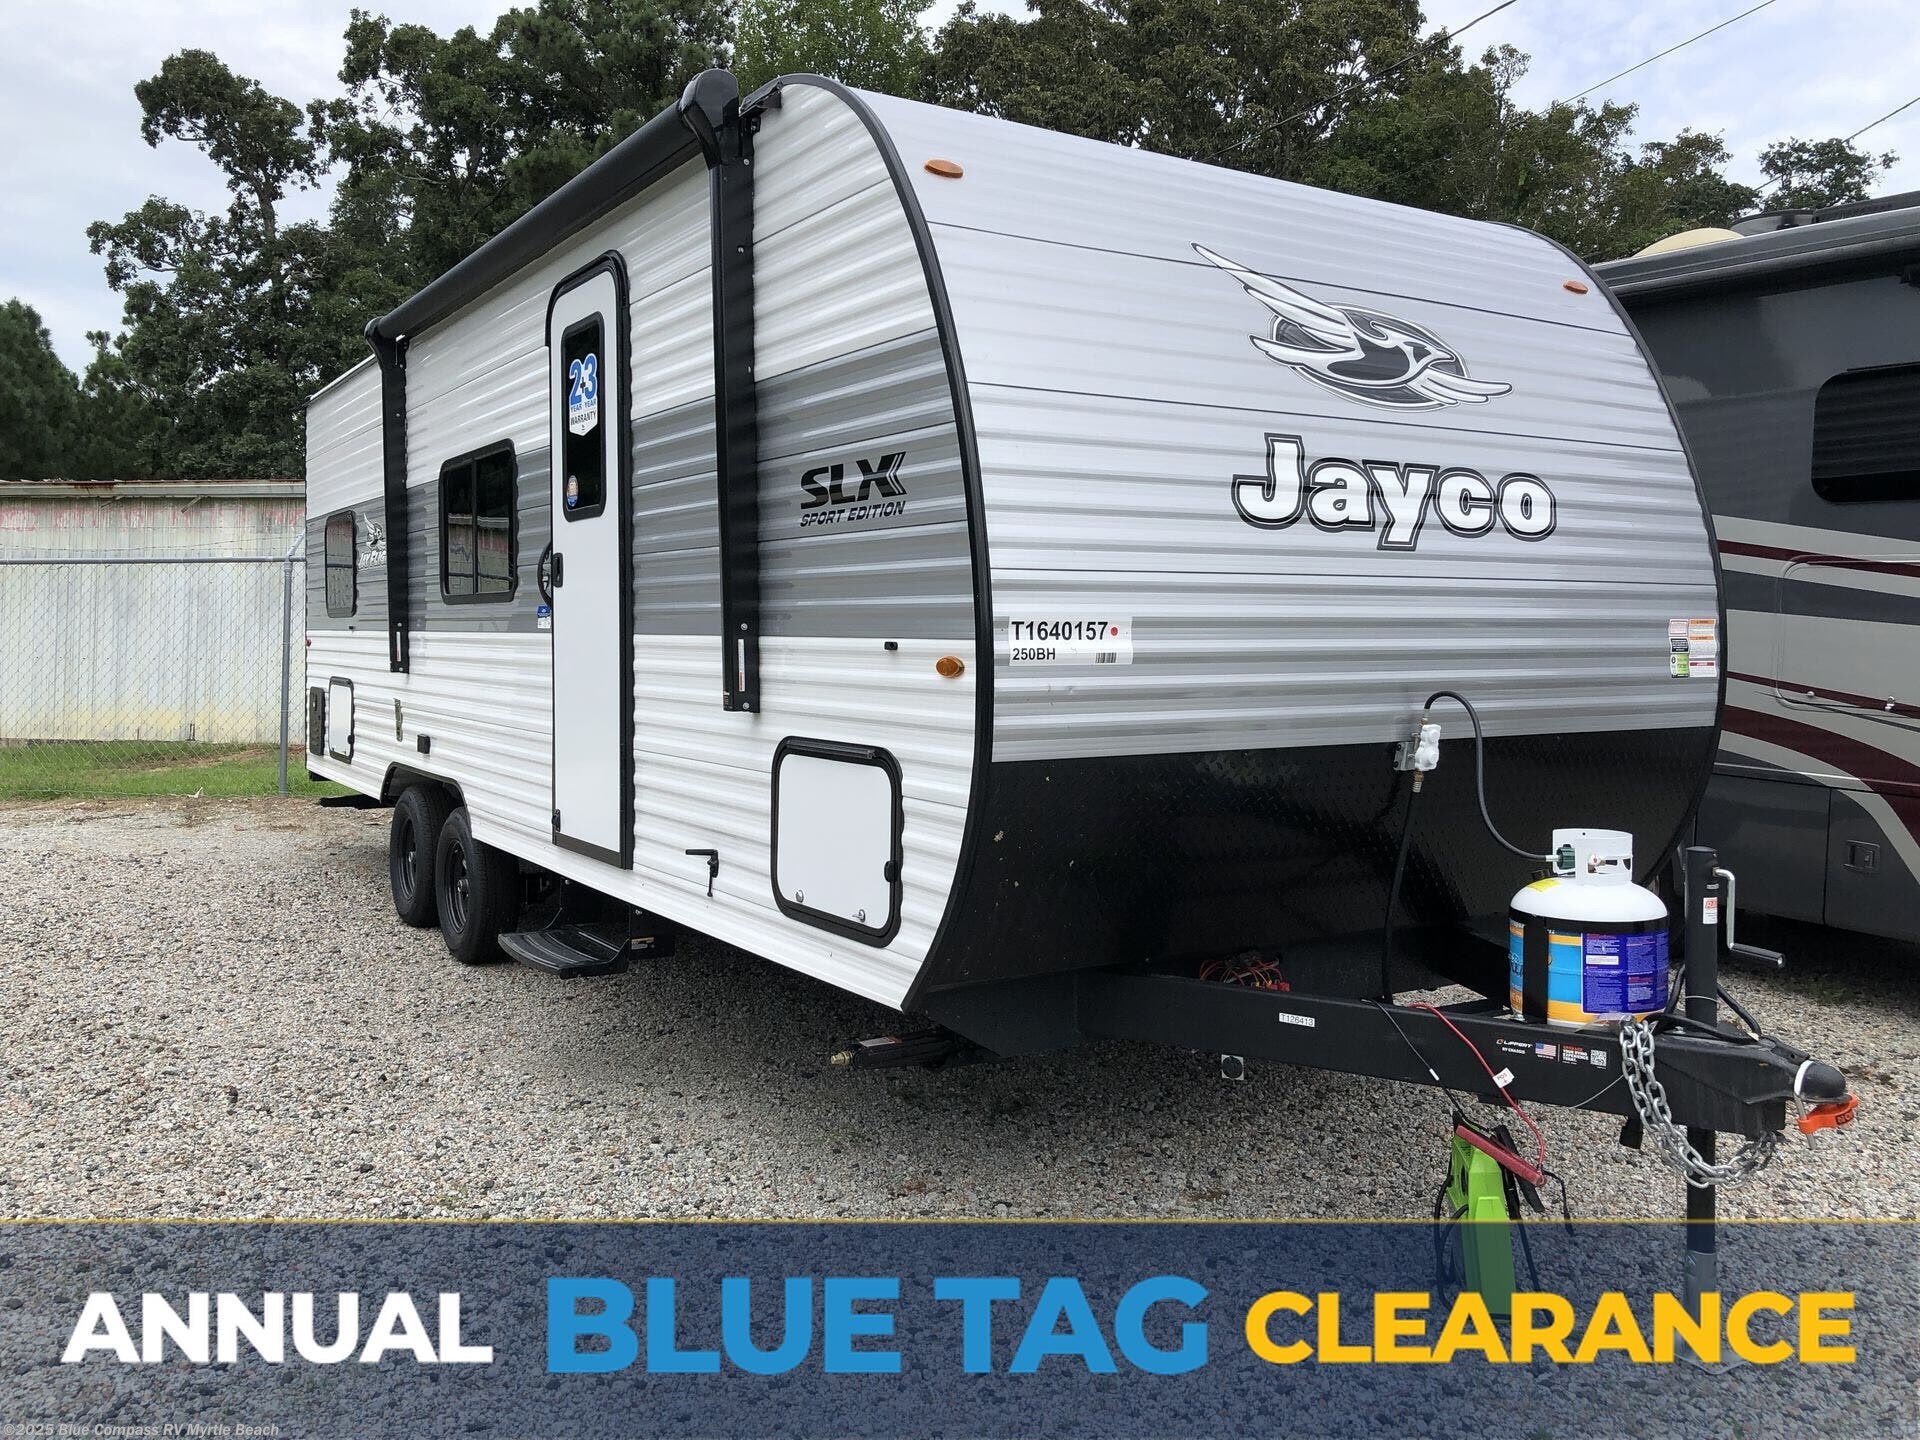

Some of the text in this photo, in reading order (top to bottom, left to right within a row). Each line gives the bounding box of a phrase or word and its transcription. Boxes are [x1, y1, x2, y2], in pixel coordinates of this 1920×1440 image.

[571, 411, 596, 425] WARRANTY
[801, 451, 907, 509] SLX
[1231, 432, 1558, 552] Jayco
[800, 500, 906, 527] SPORT EDITION
[1011, 621, 1108, 641] T1640157
[1012, 647, 1056, 661] 250BH
